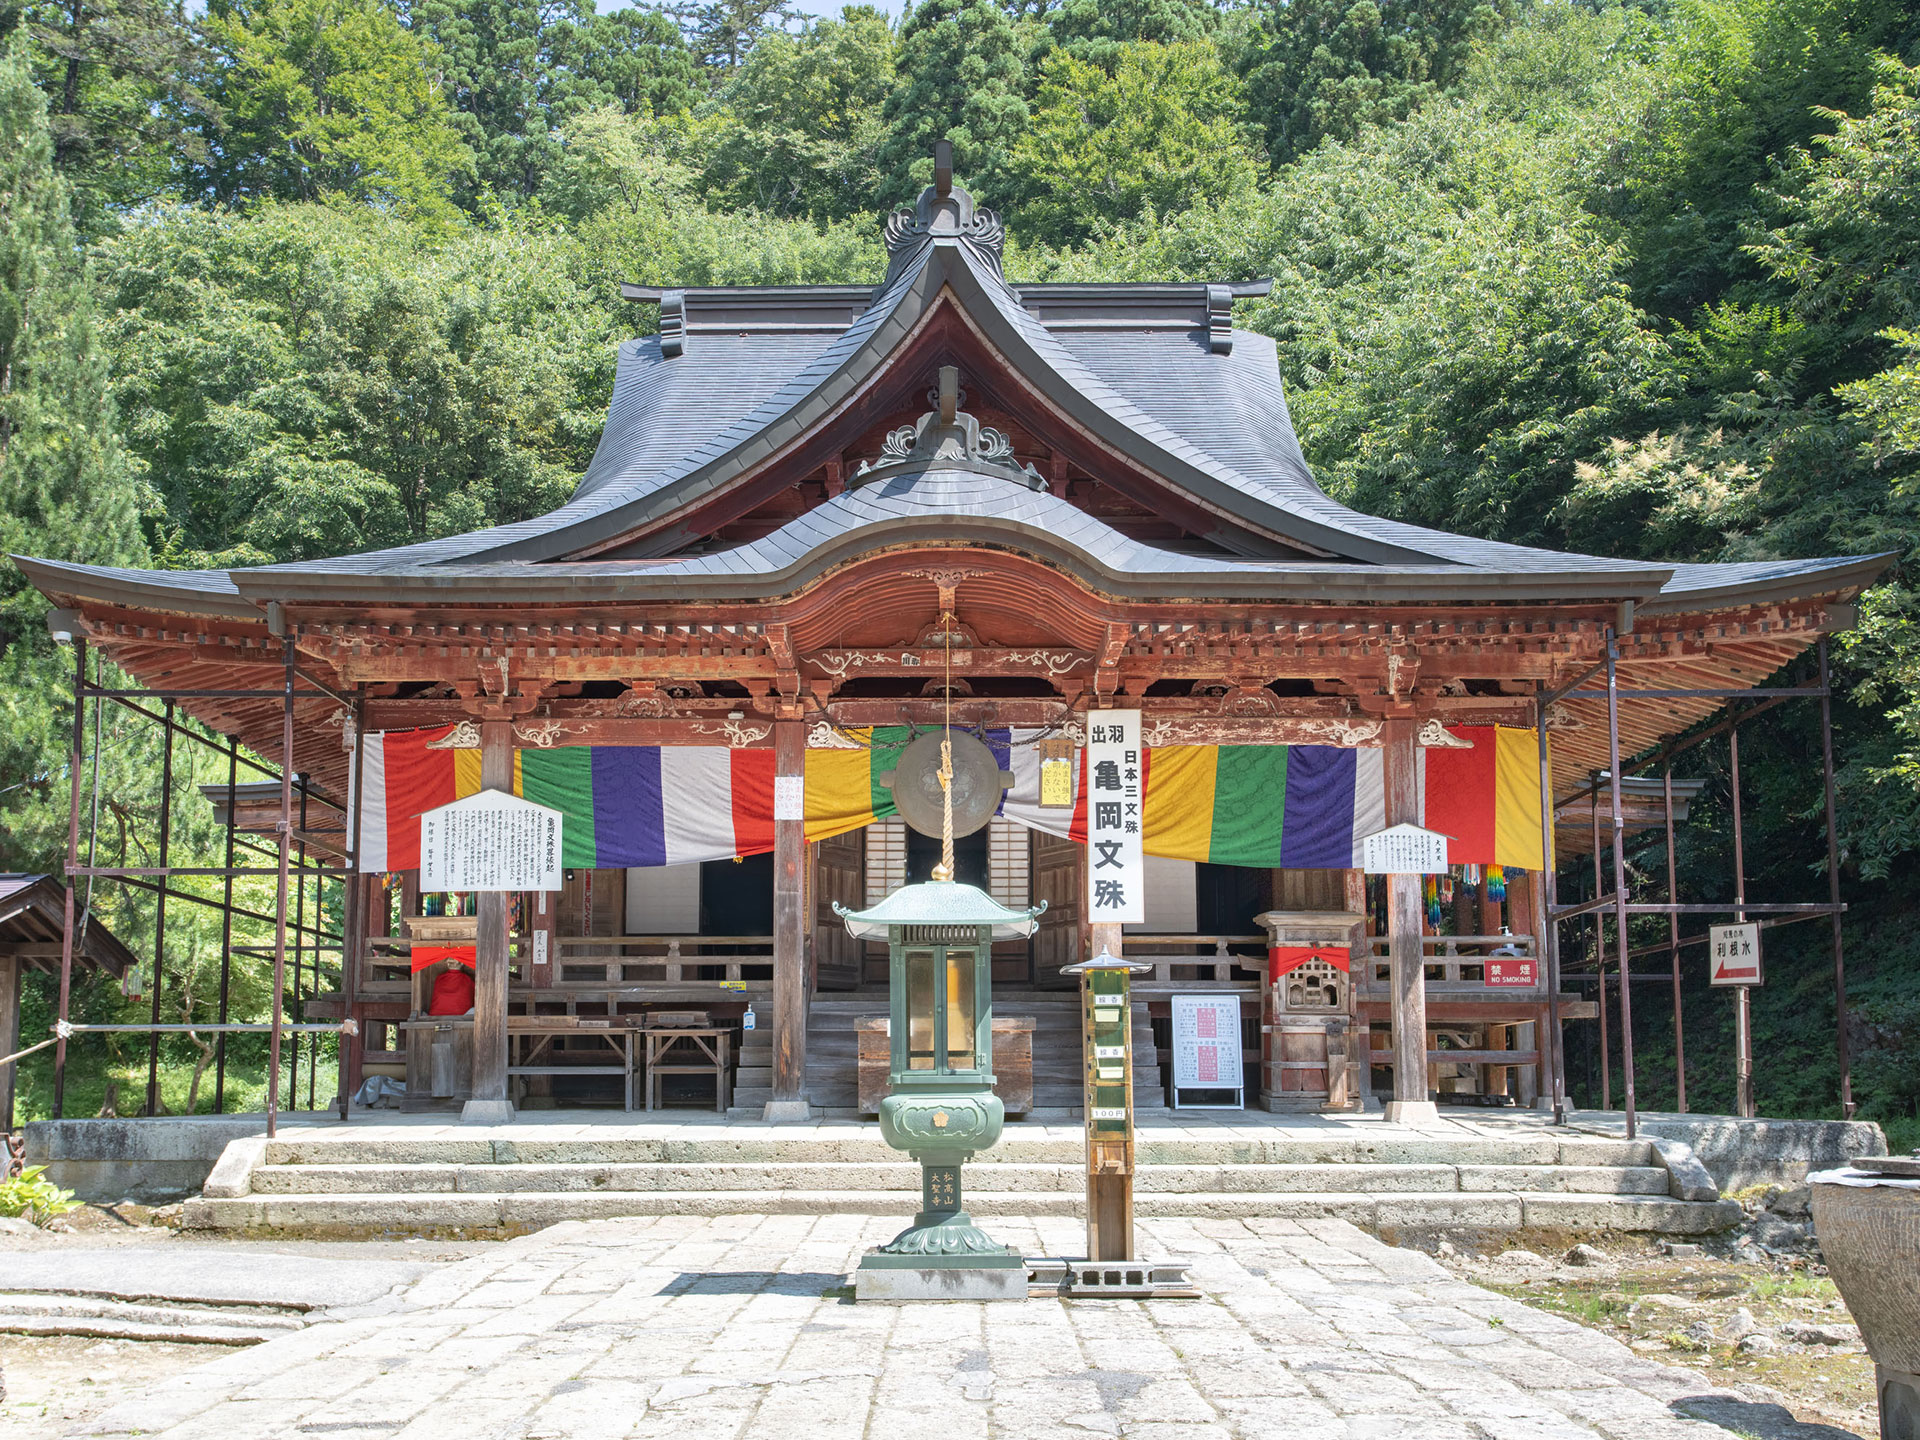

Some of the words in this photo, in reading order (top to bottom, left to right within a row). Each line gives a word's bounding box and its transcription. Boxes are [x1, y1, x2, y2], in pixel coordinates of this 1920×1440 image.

[1092, 725, 1124, 744] 出羽
[1124, 750, 1139, 834] 日本三文殊
[1094, 760, 1127, 909] 亀岡文殊
[1717, 940, 1751, 958] 利根水
[1491, 964, 1531, 976] 禁煙
[1502, 976, 1531, 984] SMOKING
[931, 1173, 942, 1206] 大聖寺
[943, 1172, 954, 1205] 松高山
